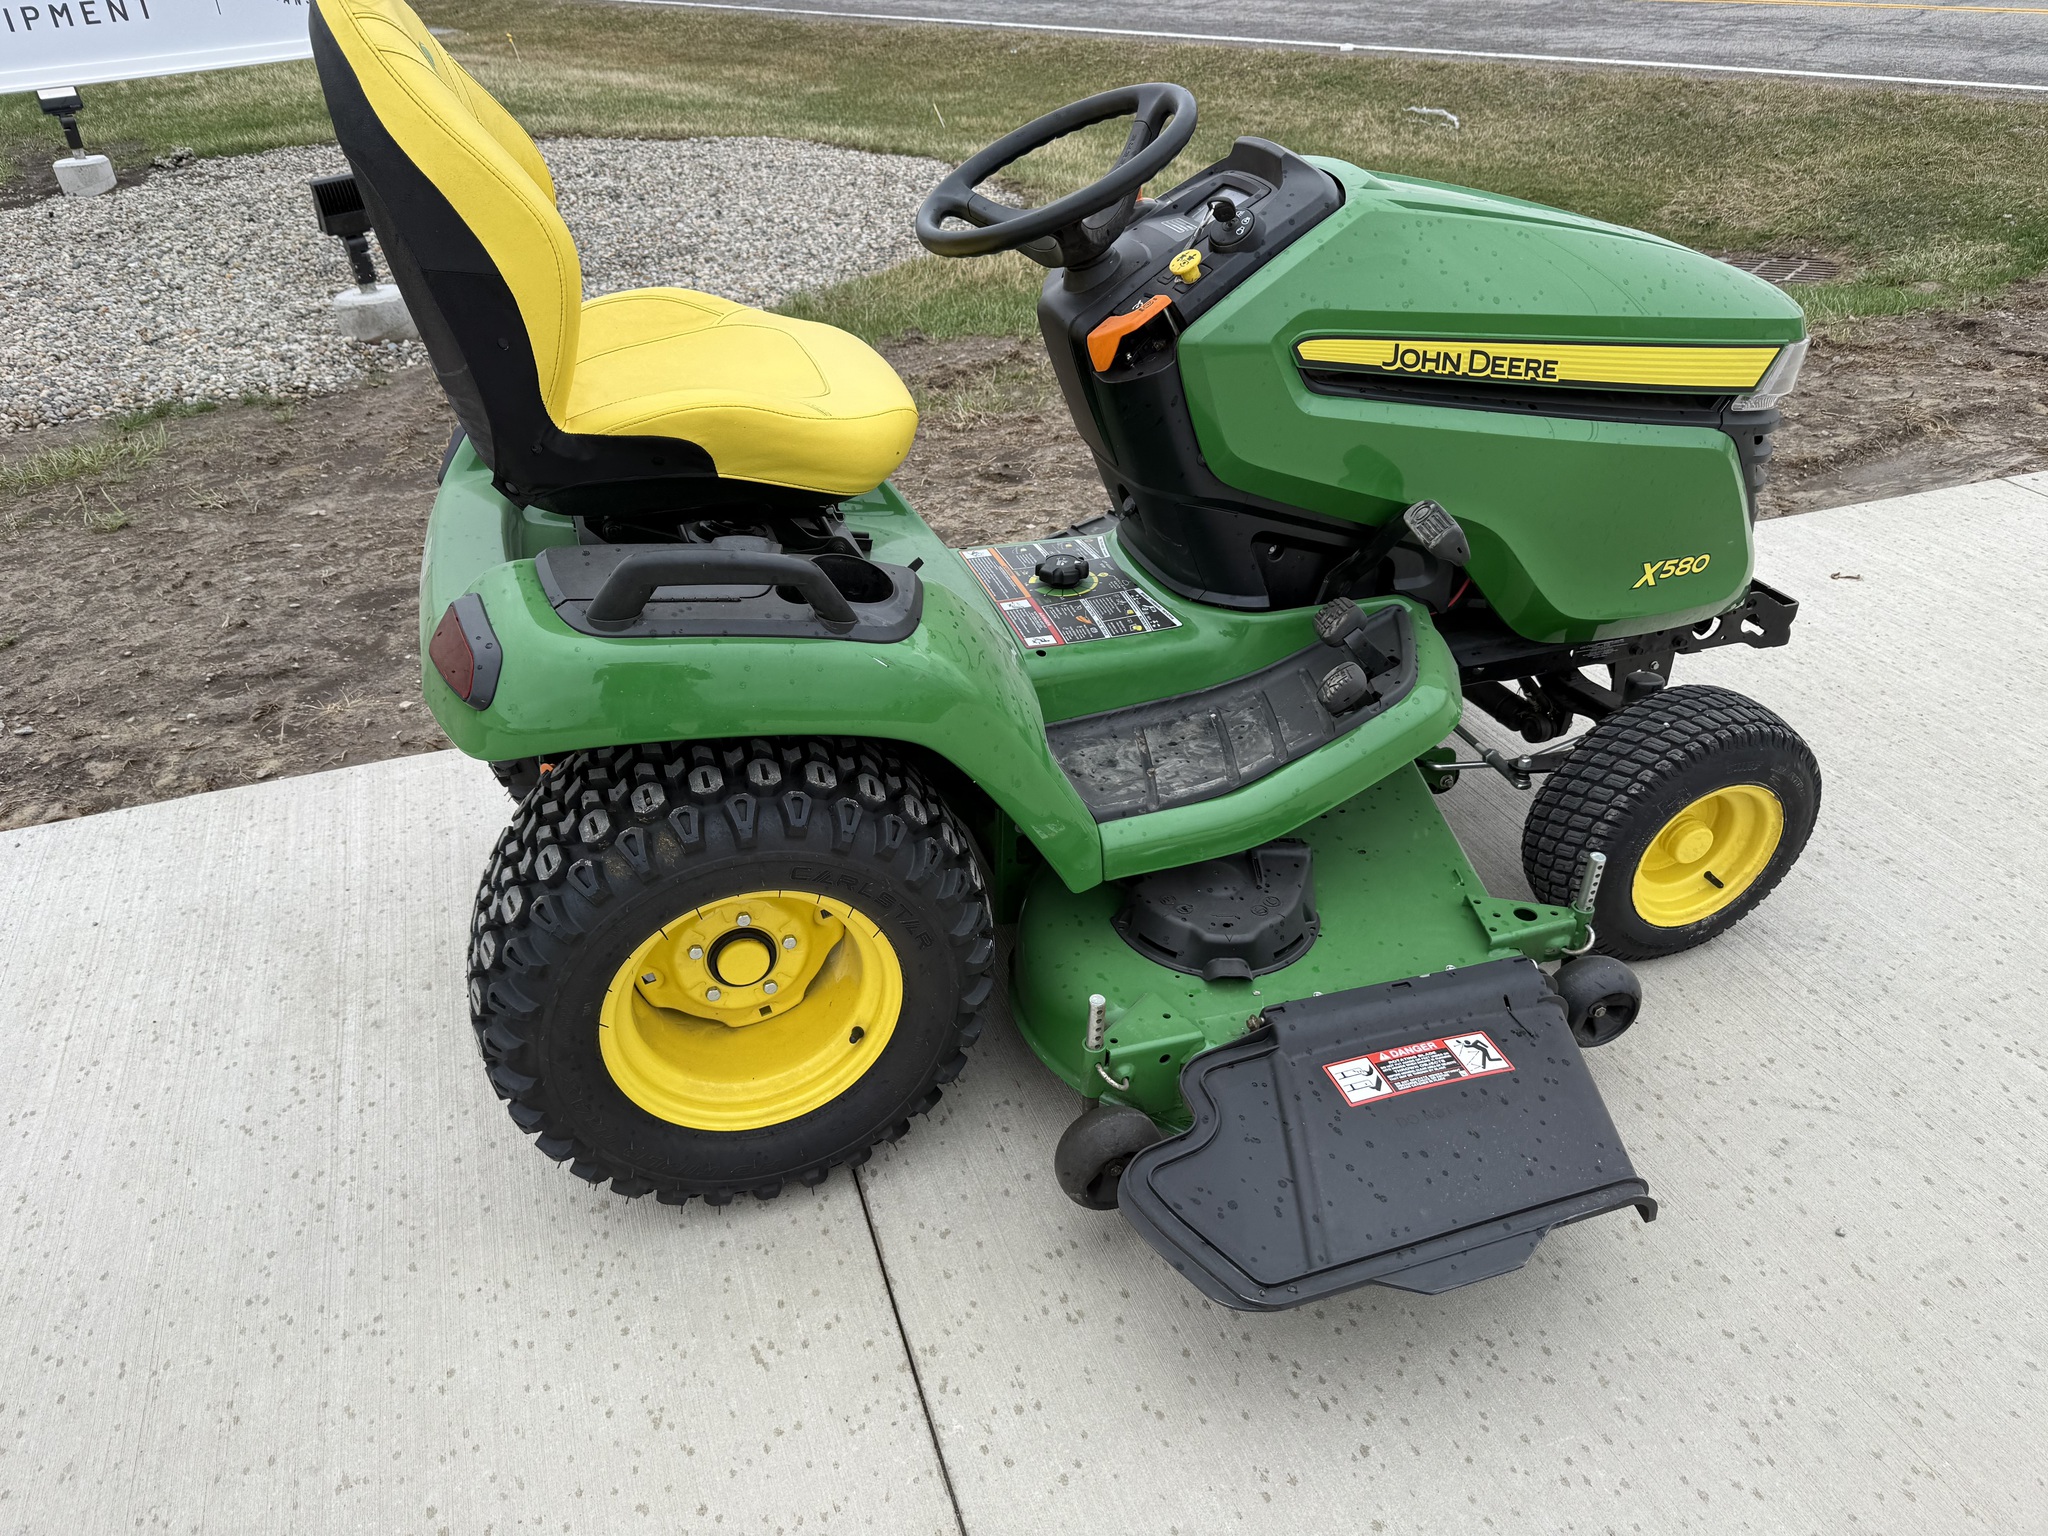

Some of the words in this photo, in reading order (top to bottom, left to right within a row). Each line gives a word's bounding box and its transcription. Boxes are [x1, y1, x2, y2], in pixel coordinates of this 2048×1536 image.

[1381, 343, 1462, 373] JOHN
[1468, 349, 1559, 379] DEERE
[1630, 553, 1711, 589] X580
[788, 865, 934, 950] CARLSTAR
[1389, 1042, 1438, 1059] DANGER
